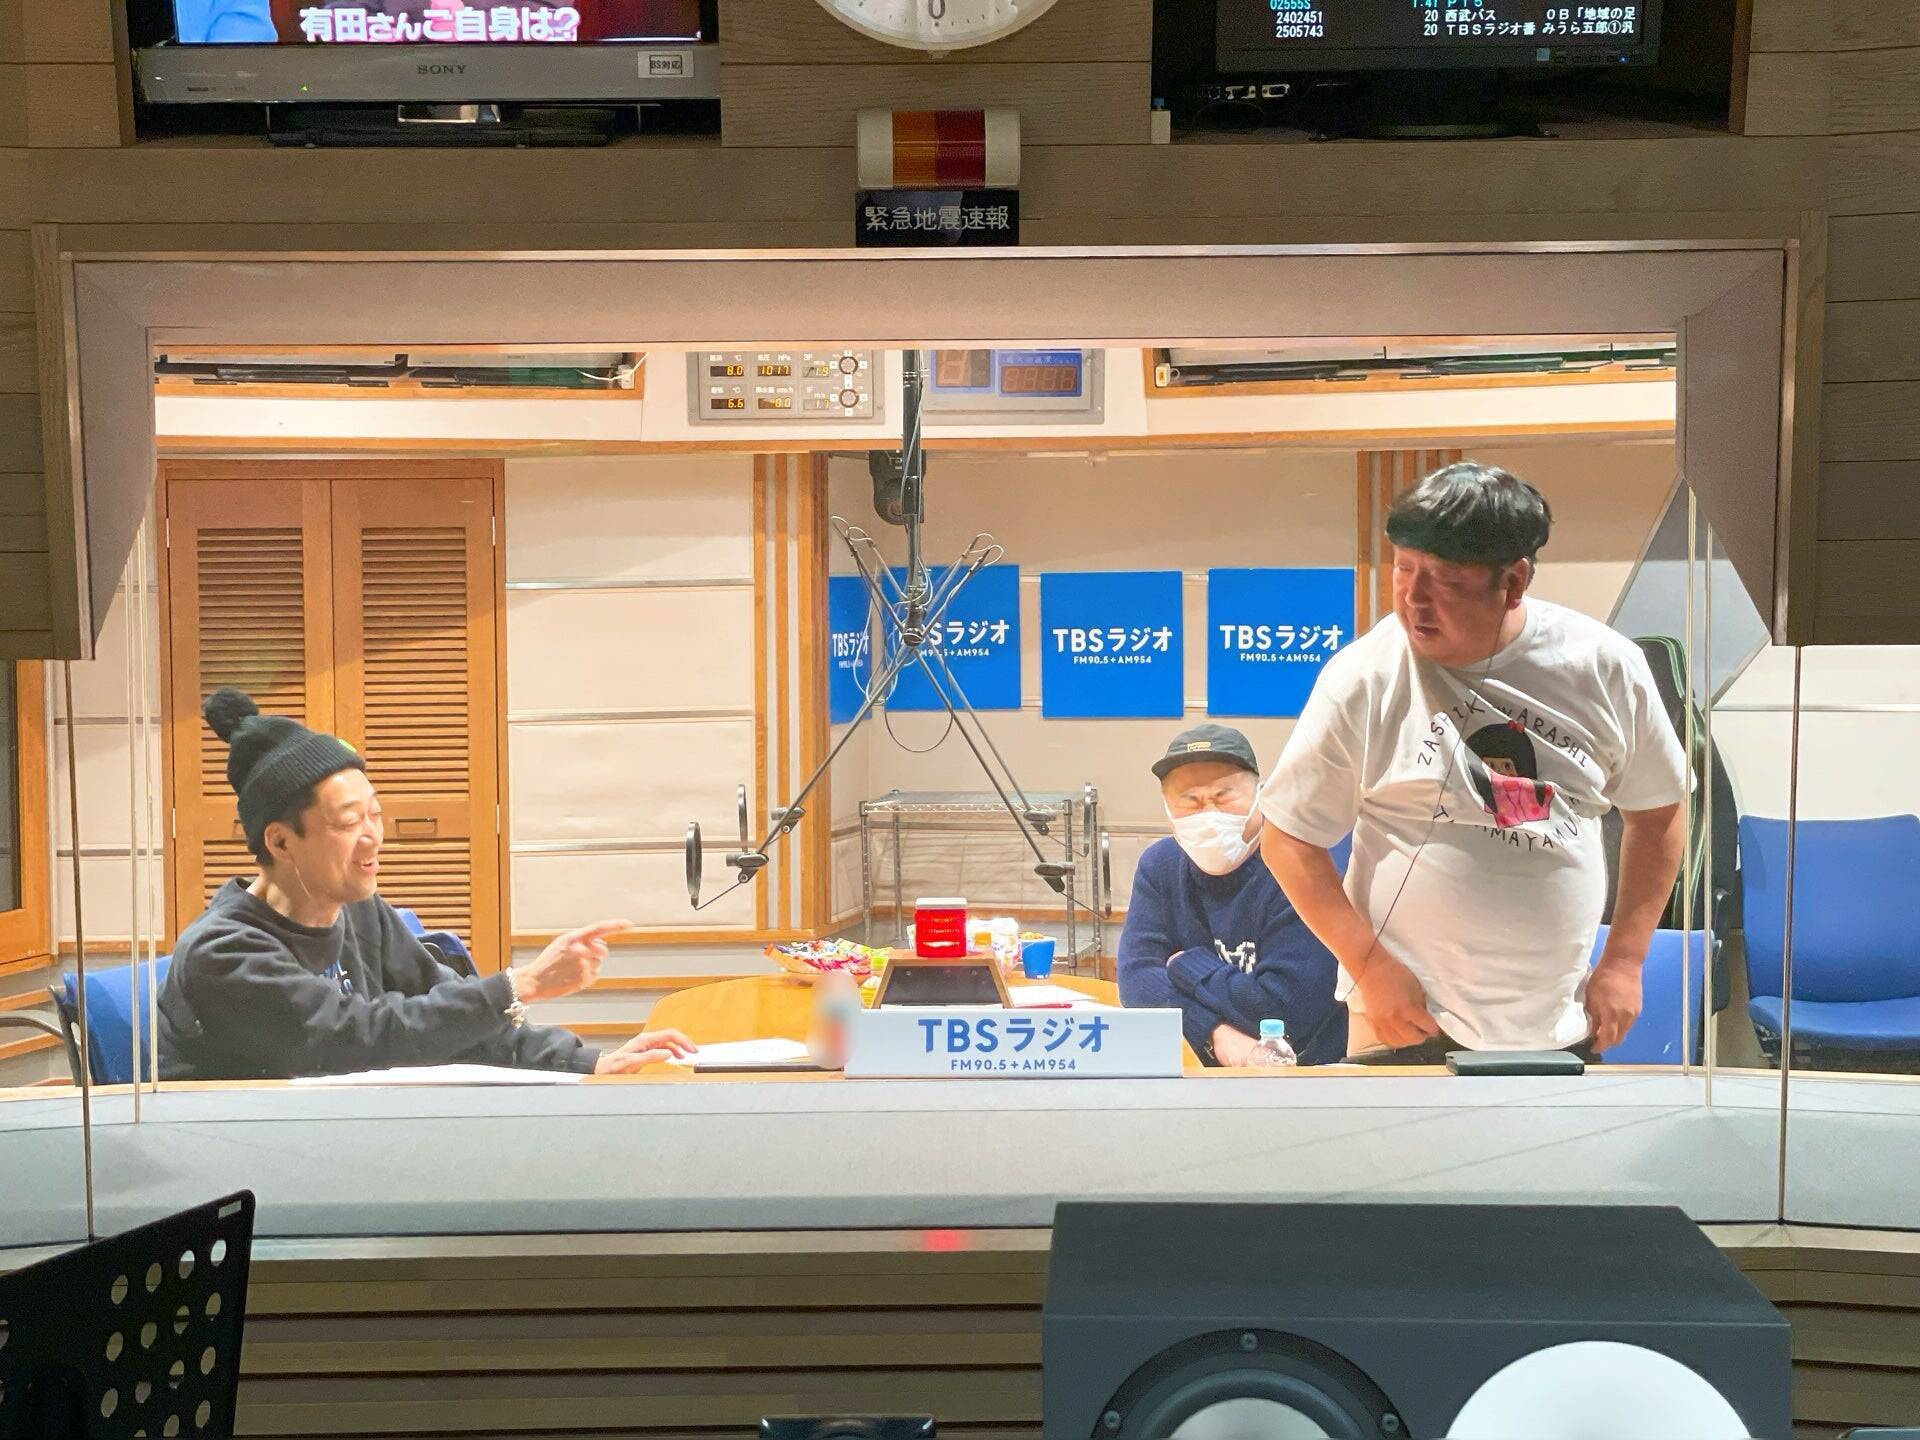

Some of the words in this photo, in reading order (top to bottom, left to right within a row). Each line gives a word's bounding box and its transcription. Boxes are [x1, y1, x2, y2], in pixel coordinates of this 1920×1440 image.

[1276, 11, 1323, 23] 2402451
[1424, 9, 1438, 21] 20
[1445, 8, 1496, 22] 西武バス
[1276, 25, 1323, 38] 2505743
[1423, 23, 1438, 36] 20
[1446, 22, 1536, 36] TBSラジオ番
[417, 64, 466, 75] SONY
[865, 206, 1010, 232] 緊急地震速報
[894, 619, 1010, 646] Sラジオ
[1053, 626, 1172, 652] TBSラジオ
[1219, 624, 1343, 650] TBSラジオ
[1073, 655, 1151, 664] FM90.5+AM954
[1240, 653, 1321, 663] FM90.5+AM954
[918, 1016, 1109, 1053] TBSラジオ
[951, 1059, 1076, 1071] FM90.5+AM954
